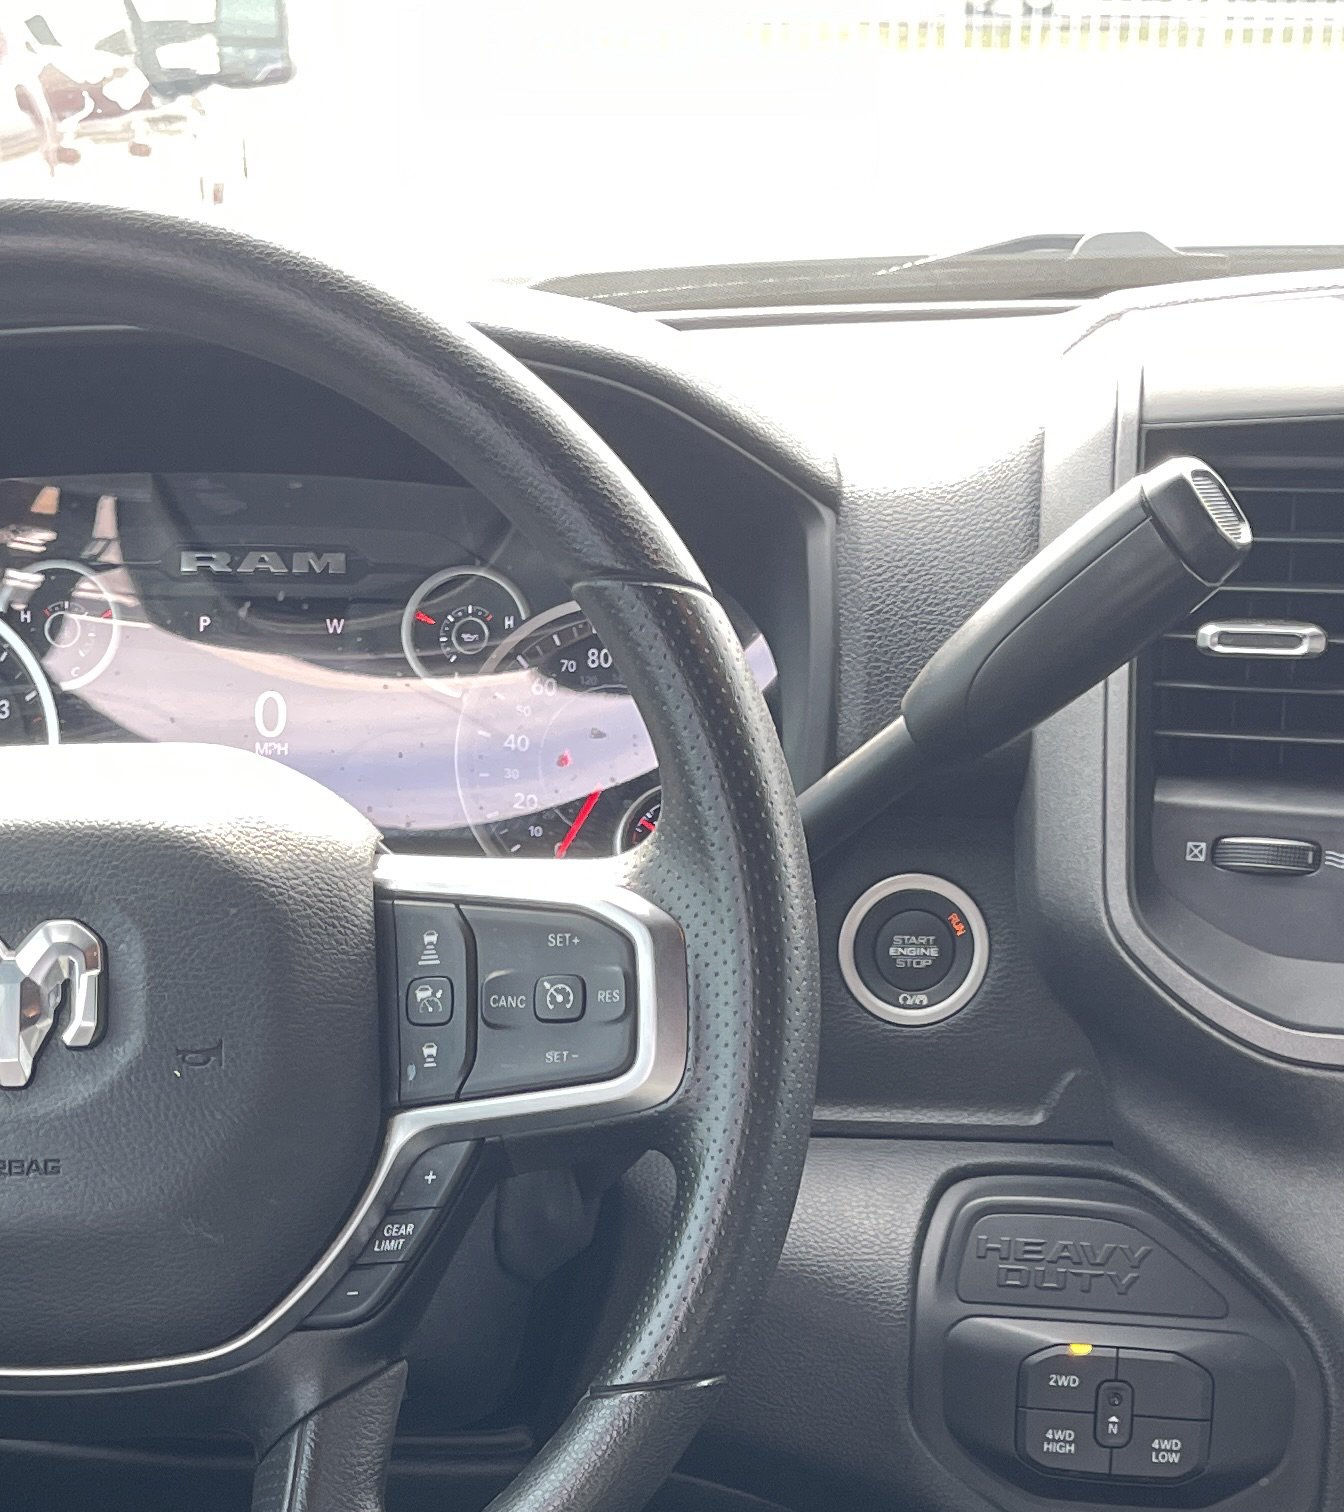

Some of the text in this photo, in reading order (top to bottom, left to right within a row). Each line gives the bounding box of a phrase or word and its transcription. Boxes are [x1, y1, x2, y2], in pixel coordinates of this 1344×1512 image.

[180, 551, 346, 575] RAM
[199, 616, 211, 632] P
[325, 618, 345, 634] W
[587, 648, 613, 668] 80
[560, 660, 577, 673] 70
[531, 678, 557, 696] 60
[254, 690, 288, 738] 0
[254, 742, 289, 756] MPH
[503, 734, 530, 751] 40
[504, 769, 519, 779] 30
[513, 792, 538, 809] 20
[529, 826, 543, 837] 10
[947, 911, 966, 937] RUN
[893, 935, 936, 945] START
[888, 947, 939, 957] ENGINE
[895, 958, 933, 969] STOP
[490, 995, 526, 1009] CANC
[597, 989, 620, 1003] RES
[383, 1223, 414, 1237] GEAR
[373, 1239, 406, 1252] LIMIT
[975, 1235, 1154, 1268] HEAVY
[995, 1264, 1141, 1296] DUTY
[1048, 1374, 1080, 1388] 2WD
[1045, 1429, 1075, 1441] 4WD
[1107, 1423, 1118, 1435] N
[1043, 1441, 1075, 1454] HIGH
[1151, 1438, 1182, 1451] 4WD
[1151, 1451, 1181, 1464] LOW
